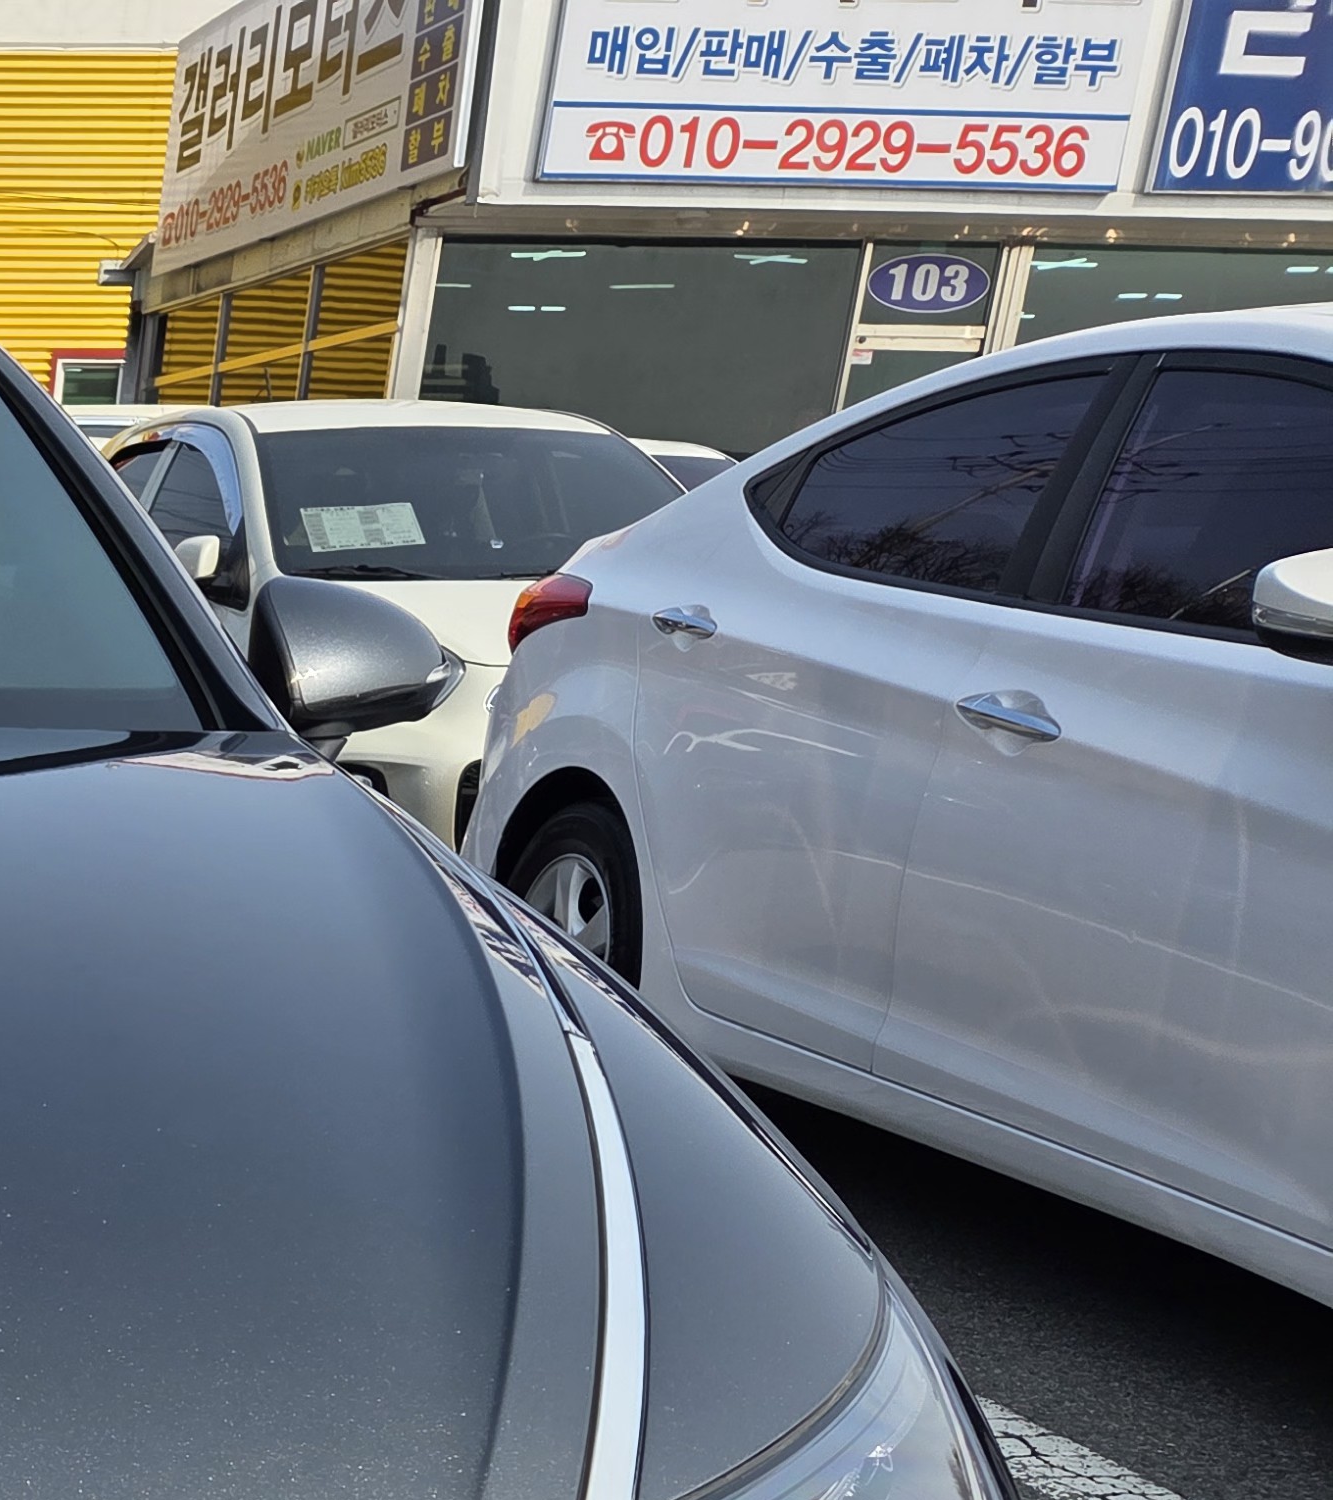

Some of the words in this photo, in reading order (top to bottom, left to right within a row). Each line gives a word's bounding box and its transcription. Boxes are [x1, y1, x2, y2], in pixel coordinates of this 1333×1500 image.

[177, 0, 404, 173] 갤러리모터스
[588, 25, 1121, 88] 매입/판매/수출/폐차/할부
[306, 127, 342, 162] NAVER
[640, 115, 1089, 177] 010-2929-5536
[174, 160, 288, 245] 010-2929-5536
[889, 263, 968, 302] 103
